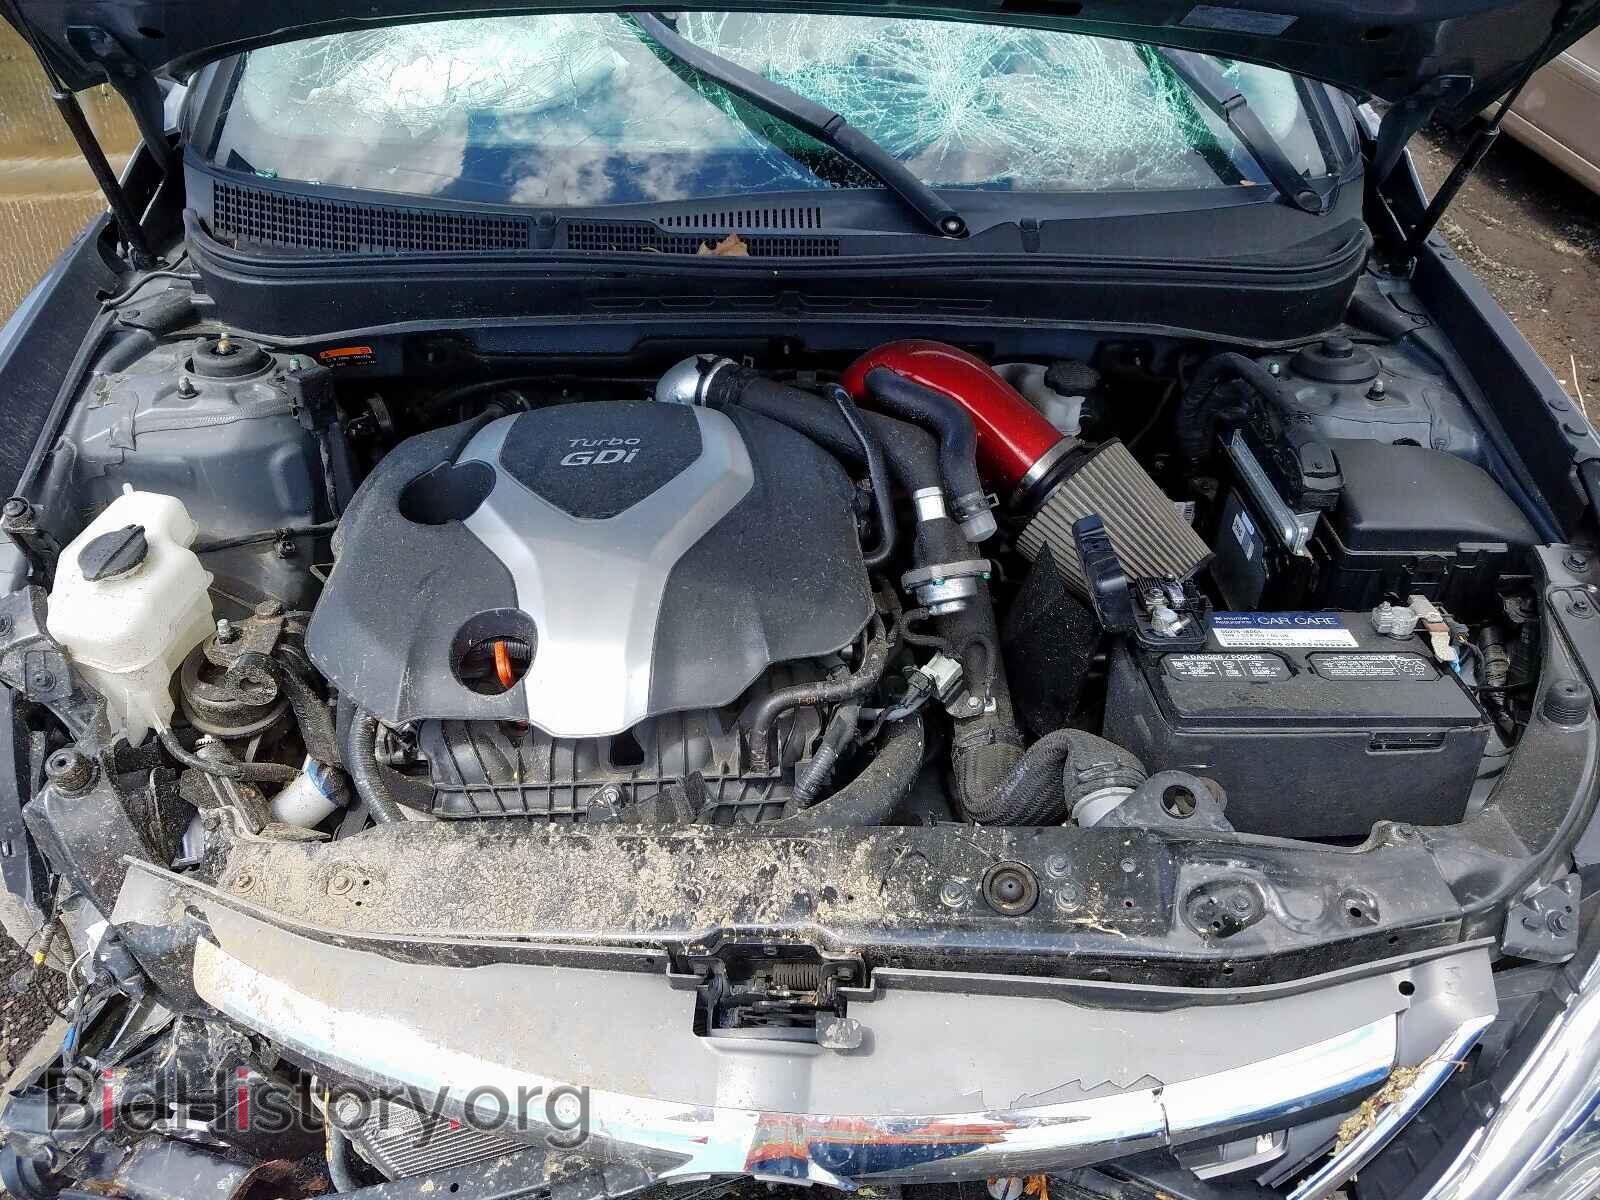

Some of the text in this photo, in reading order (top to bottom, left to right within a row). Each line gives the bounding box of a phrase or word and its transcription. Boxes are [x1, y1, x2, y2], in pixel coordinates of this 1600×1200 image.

[569, 437, 641, 448] Turbo
[560, 448, 641, 466] GDi
[1258, 616, 1291, 625] CAR
[1295, 616, 1338, 625] CARE
